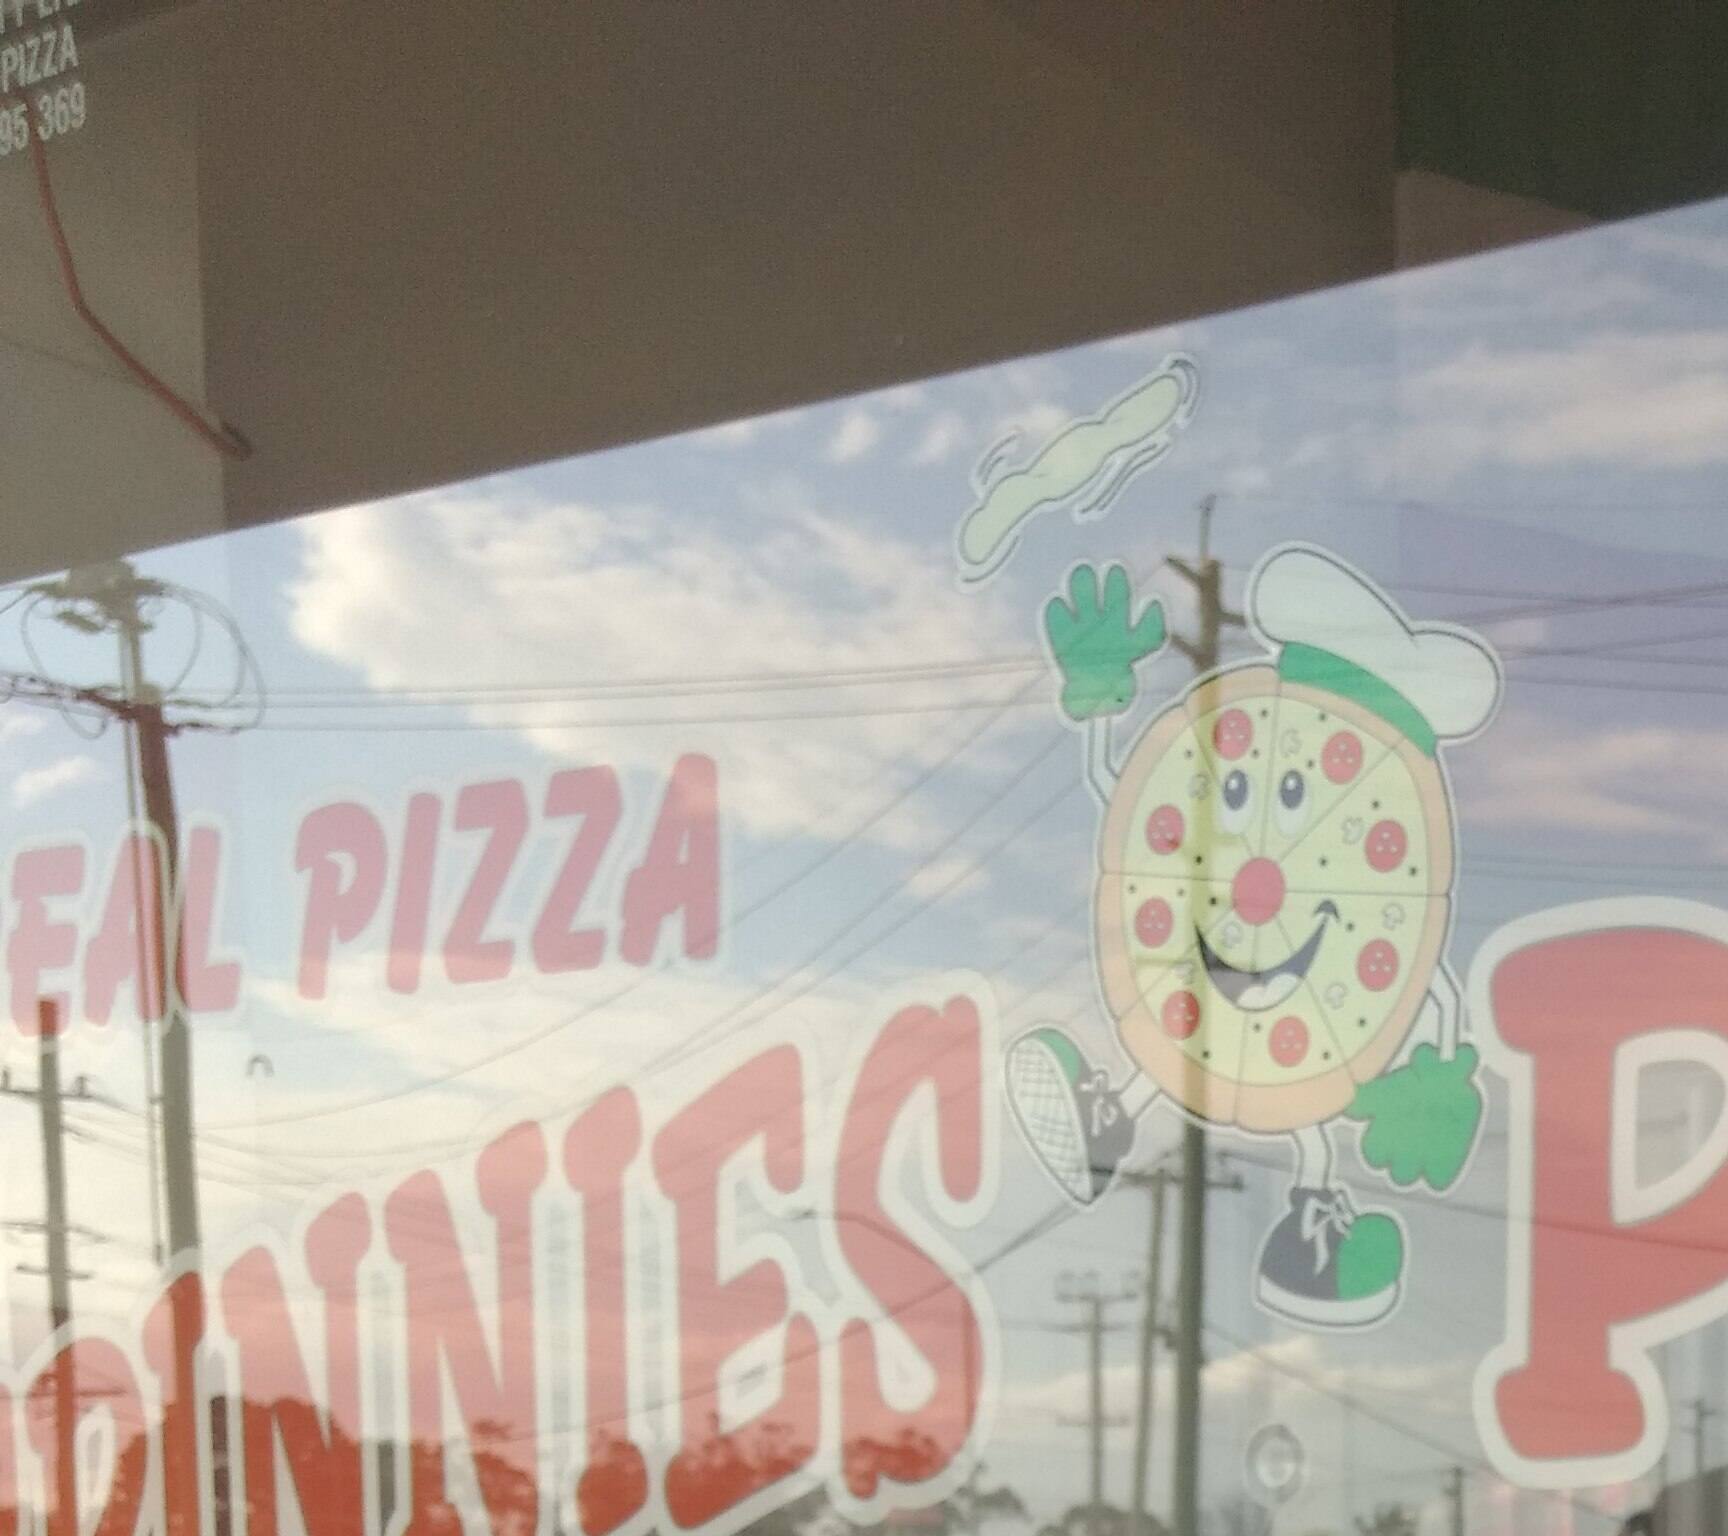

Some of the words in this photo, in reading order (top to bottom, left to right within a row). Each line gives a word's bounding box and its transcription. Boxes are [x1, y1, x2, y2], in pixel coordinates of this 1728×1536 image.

[1, 24, 80, 93] PIZZA
[37, 82, 86, 141] 369
[292, 750, 722, 1002] PIZZA
